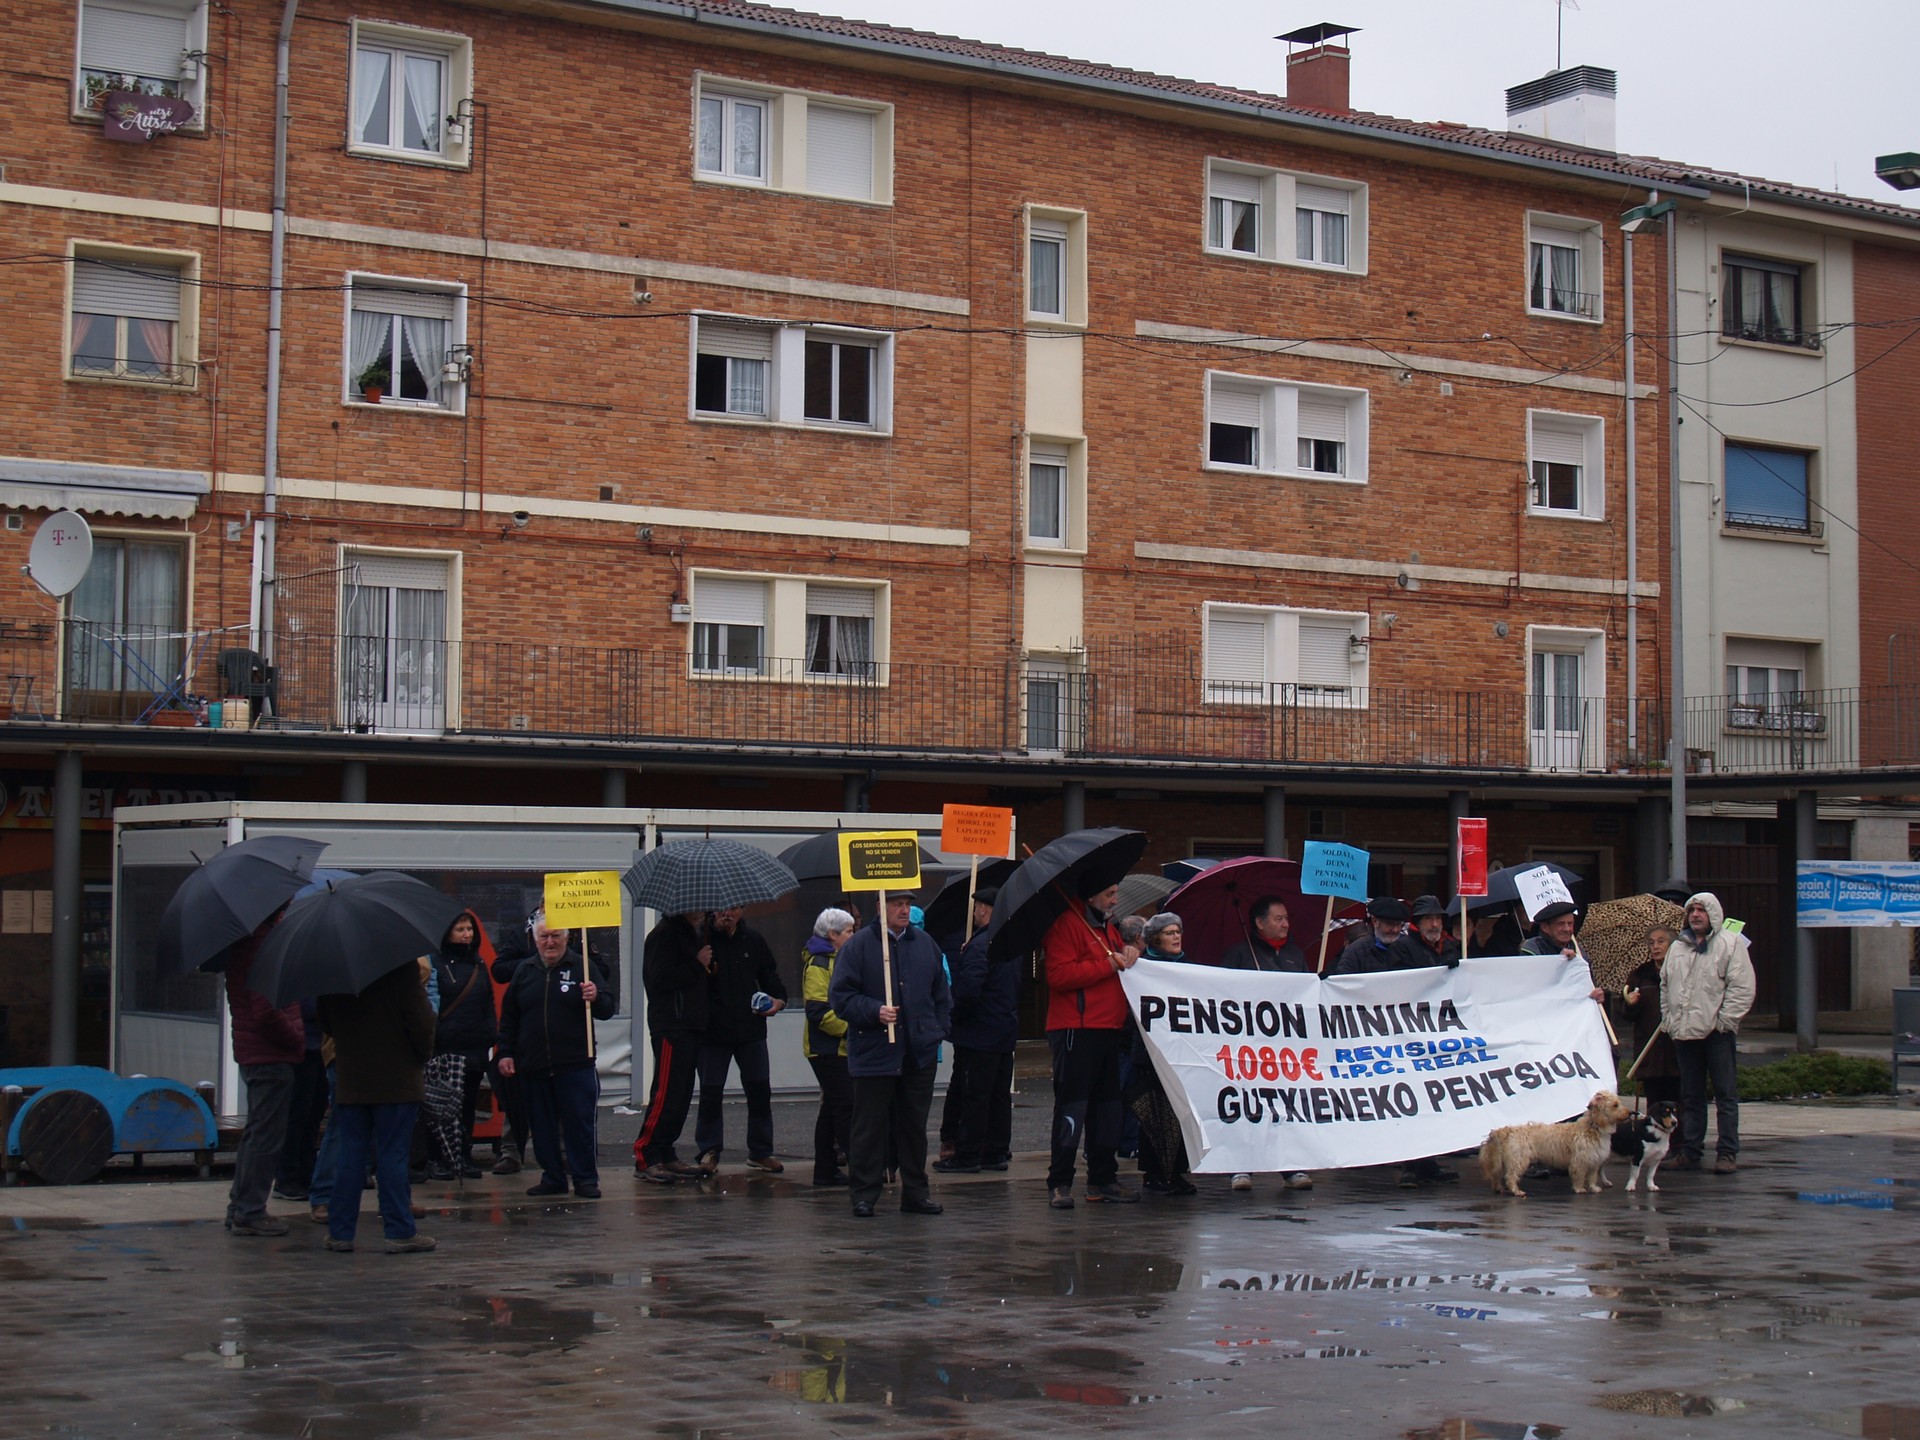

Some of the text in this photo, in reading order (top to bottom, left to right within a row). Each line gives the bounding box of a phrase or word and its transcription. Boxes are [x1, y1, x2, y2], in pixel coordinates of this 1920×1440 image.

[956, 827, 997, 836] LAPURTZEN
[863, 841, 888, 849] SERVICIOS
[888, 840, 913, 848] PÚBLICOS
[963, 836, 988, 844] DIZUTE
[1321, 849, 1355, 861] SOLDATA
[1325, 859, 1350, 869] DUINA
[1314, 869, 1357, 882] PENTSIOAK
[558, 878, 605, 887] PENTSIOAK
[1319, 880, 1350, 890] DUINAK
[1797, 879, 1824, 890] orain
[1847, 879, 1875, 891] orain
[1897, 880, 1920, 892] orai
[562, 889, 602, 898] ESKUBIDE
[1797, 890, 1831, 900] resoak
[1838, 889, 1883, 902] presoak
[1889, 891, 1920, 903] preso
[567, 900, 611, 909] NEGOZIOA
[1139, 995, 1468, 1040] PENSION MINIMA
[1335, 1036, 1488, 1064] REVISION
[1329, 1049, 1499, 1079] I.P.C. REAL
[1217, 1051, 1600, 1124] GUTXIENEKO PENTSIOA
